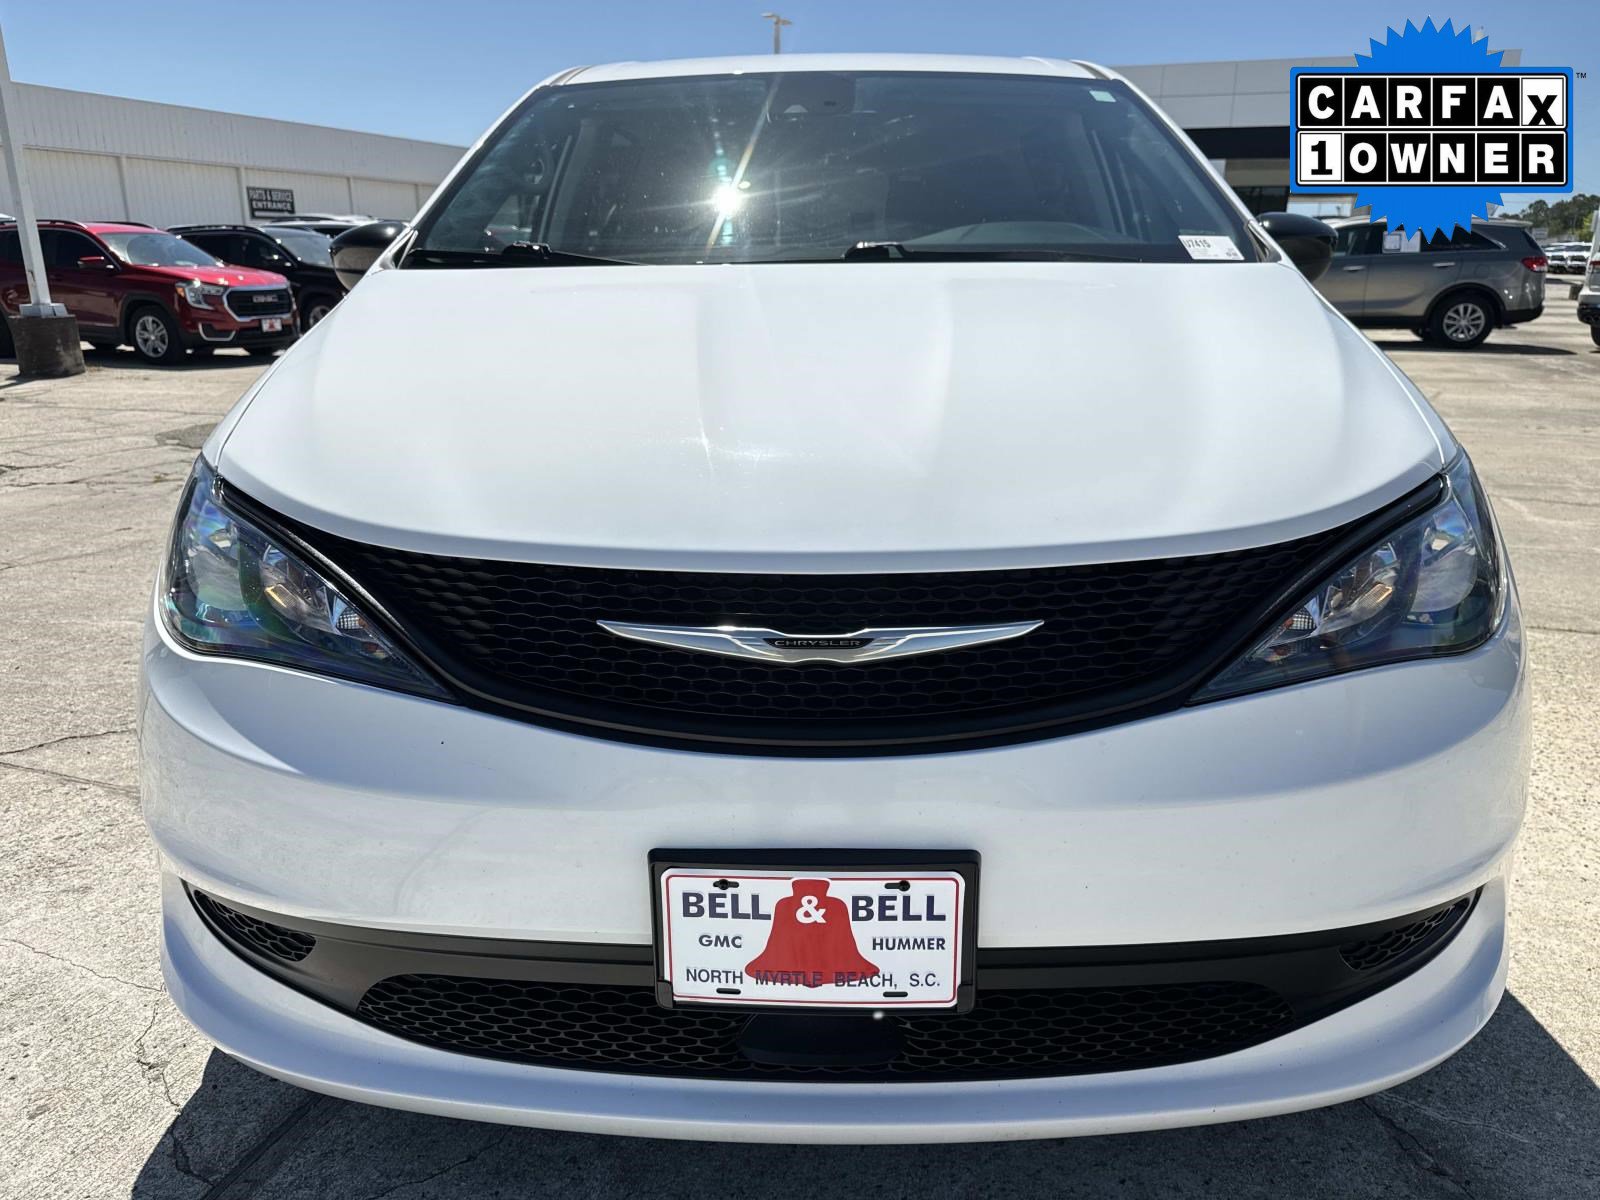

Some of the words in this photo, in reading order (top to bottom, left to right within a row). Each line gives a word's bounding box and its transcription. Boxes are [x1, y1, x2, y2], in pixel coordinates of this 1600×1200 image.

[252, 200, 292, 211] ENTRANCE
[774, 639, 862, 647] CHRYSLER
[682, 891, 771, 921] BELL
[795, 894, 827, 925] &
[851, 895, 946, 922] BELL
[698, 934, 743, 949] GMC
[871, 936, 946, 951] HUMMER
[685, 968, 744, 985] NORTH
[754, 969, 823, 988] MYRTLE
[834, 971, 898, 990] BEACH,
[908, 973, 941, 988] S.C.
